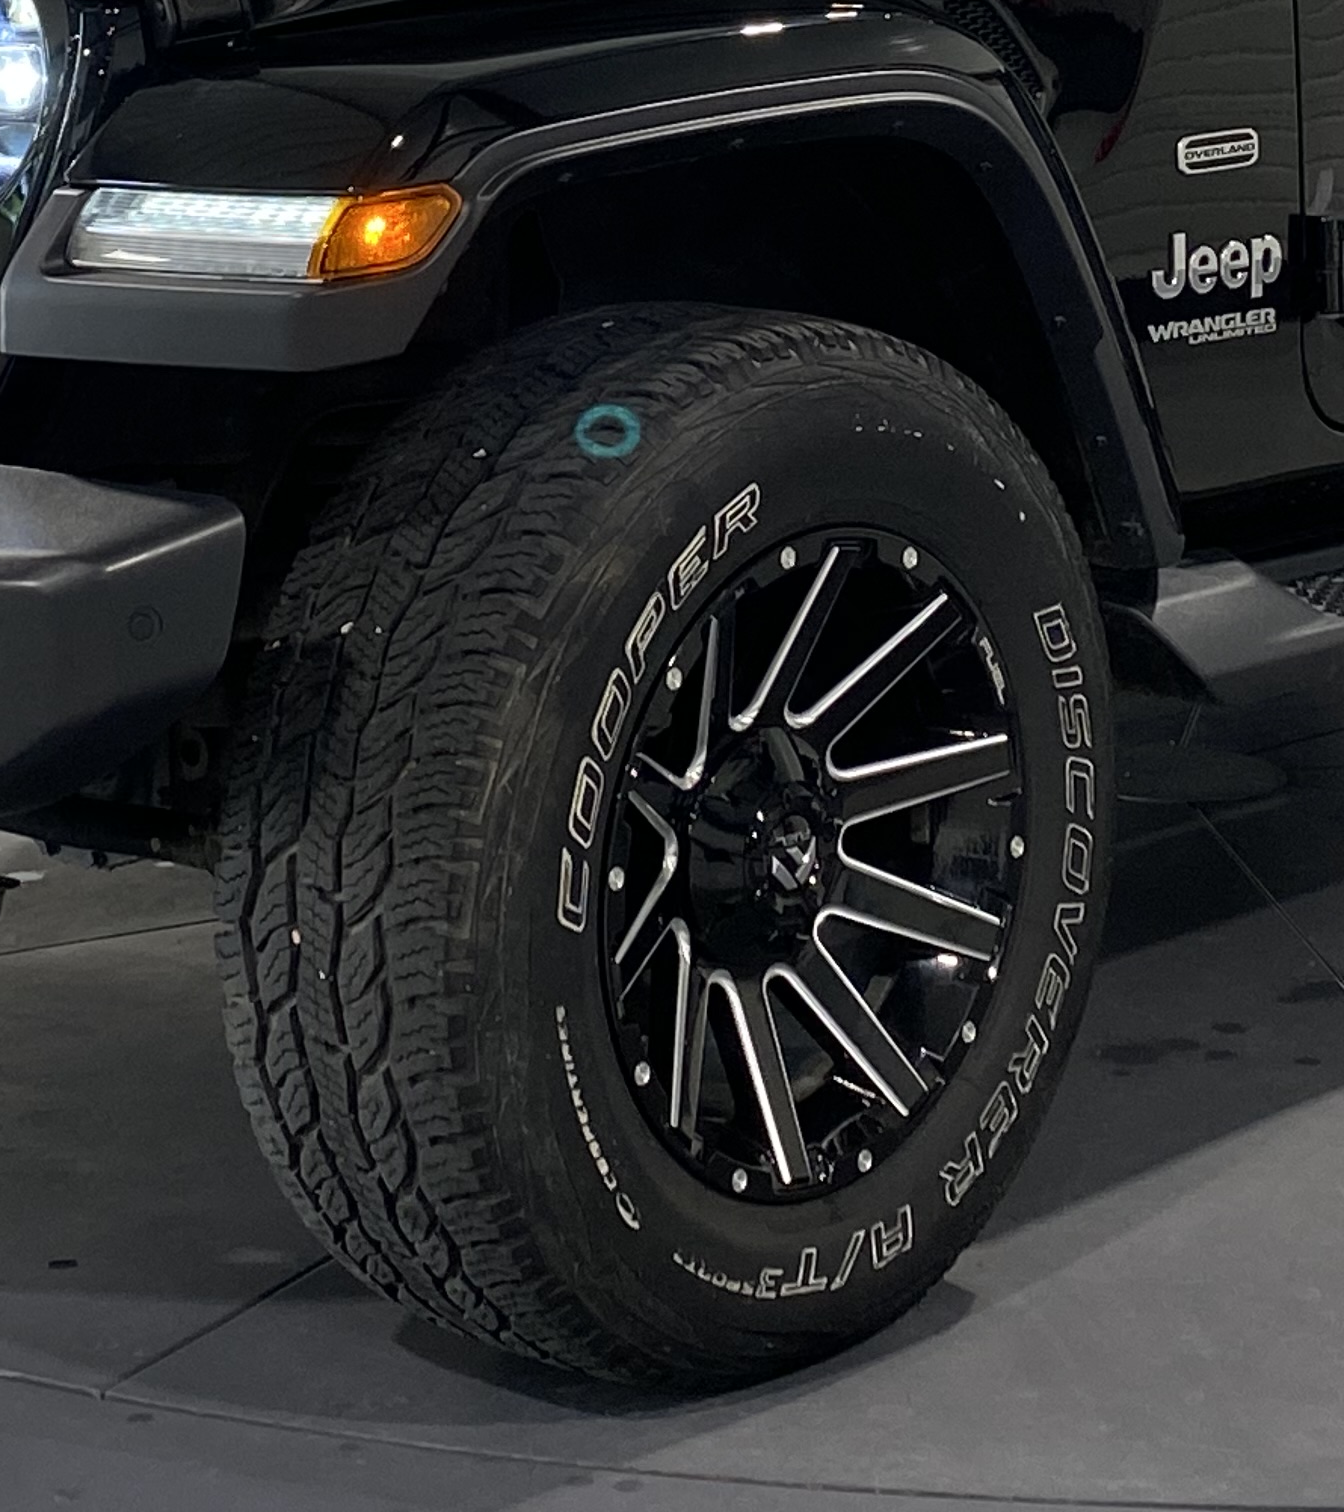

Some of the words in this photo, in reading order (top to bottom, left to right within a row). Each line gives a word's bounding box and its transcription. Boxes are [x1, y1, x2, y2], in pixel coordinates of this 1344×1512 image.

[1183, 141, 1256, 162] OVERLAND
[1151, 232, 1283, 300] Jeep
[1147, 306, 1277, 343] WRANGLER
[1188, 321, 1277, 345] UNLIMITED
[556, 482, 761, 934] COOPER
[938, 603, 1095, 1207] DISCOVERER
